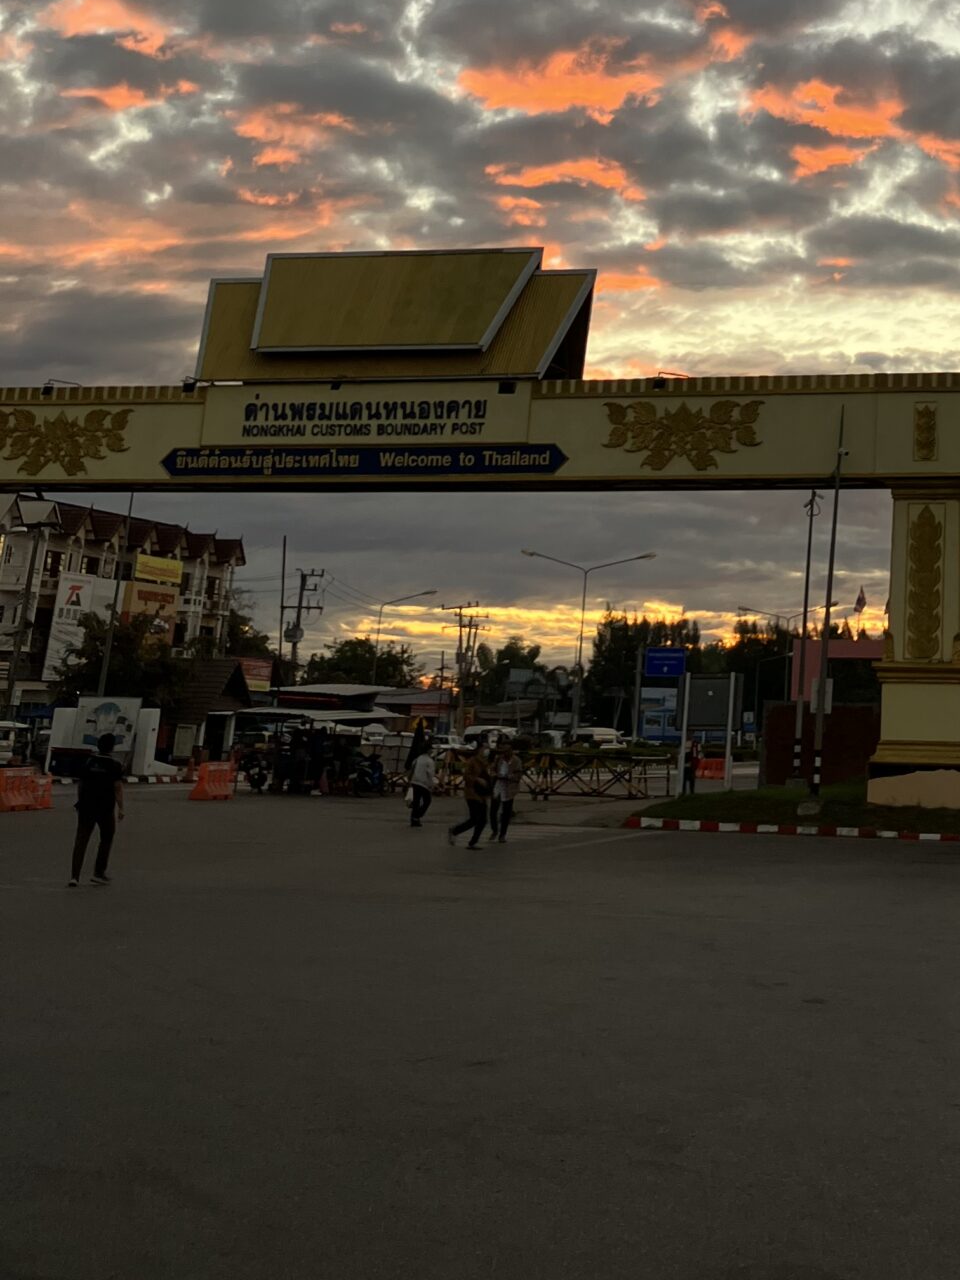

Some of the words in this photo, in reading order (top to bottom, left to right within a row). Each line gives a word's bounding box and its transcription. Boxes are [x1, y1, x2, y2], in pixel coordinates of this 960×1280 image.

[245, 393, 487, 421] ด่านพรมแดนหนองคาย
[242, 424, 306, 437] NONGKHAI
[311, 423, 371, 436] CUSTOMS
[377, 422, 447, 436] BOUNDARY
[451, 422, 486, 435] POST
[175, 448, 360, 476] ยินดีต้อนรับสู่ประเทศไทย
[379, 451, 452, 468] Welcome
[459, 452, 475, 467] to
[482, 450, 551, 467] Thailand
